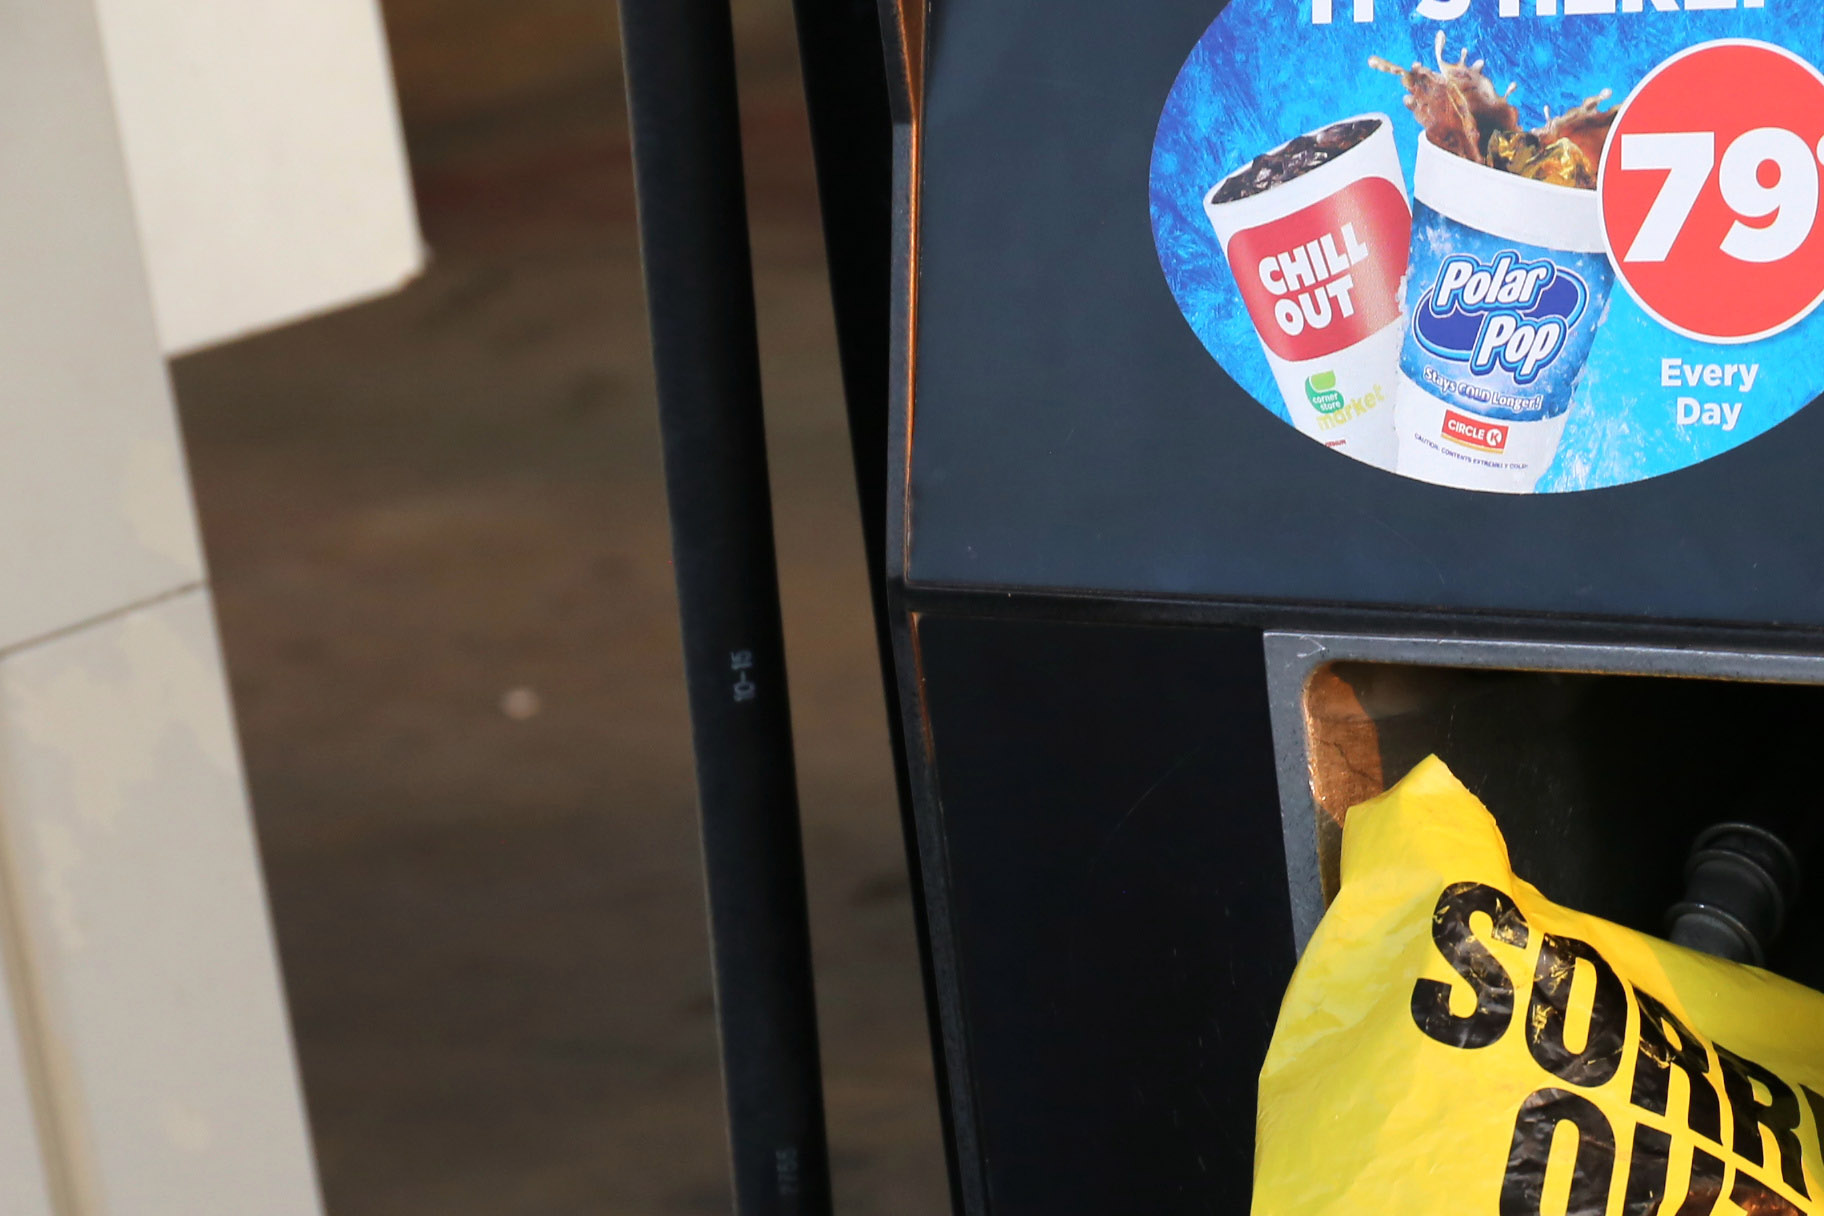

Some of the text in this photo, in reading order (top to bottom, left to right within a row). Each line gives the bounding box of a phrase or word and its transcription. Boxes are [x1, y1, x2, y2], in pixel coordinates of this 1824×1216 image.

[1257, 222, 1369, 298] CHILL
[1436, 257, 1543, 310] Polar
[1273, 282, 1355, 337] OUT
[1476, 310, 1560, 375] Pop
[1423, 366, 1457, 392] Stays
[1661, 357, 1760, 393] Every
[1312, 393, 1339, 405] corner
[1319, 400, 1342, 411] store
[1676, 397, 1746, 431] Day
[1447, 419, 1485, 440] CIRCLE
